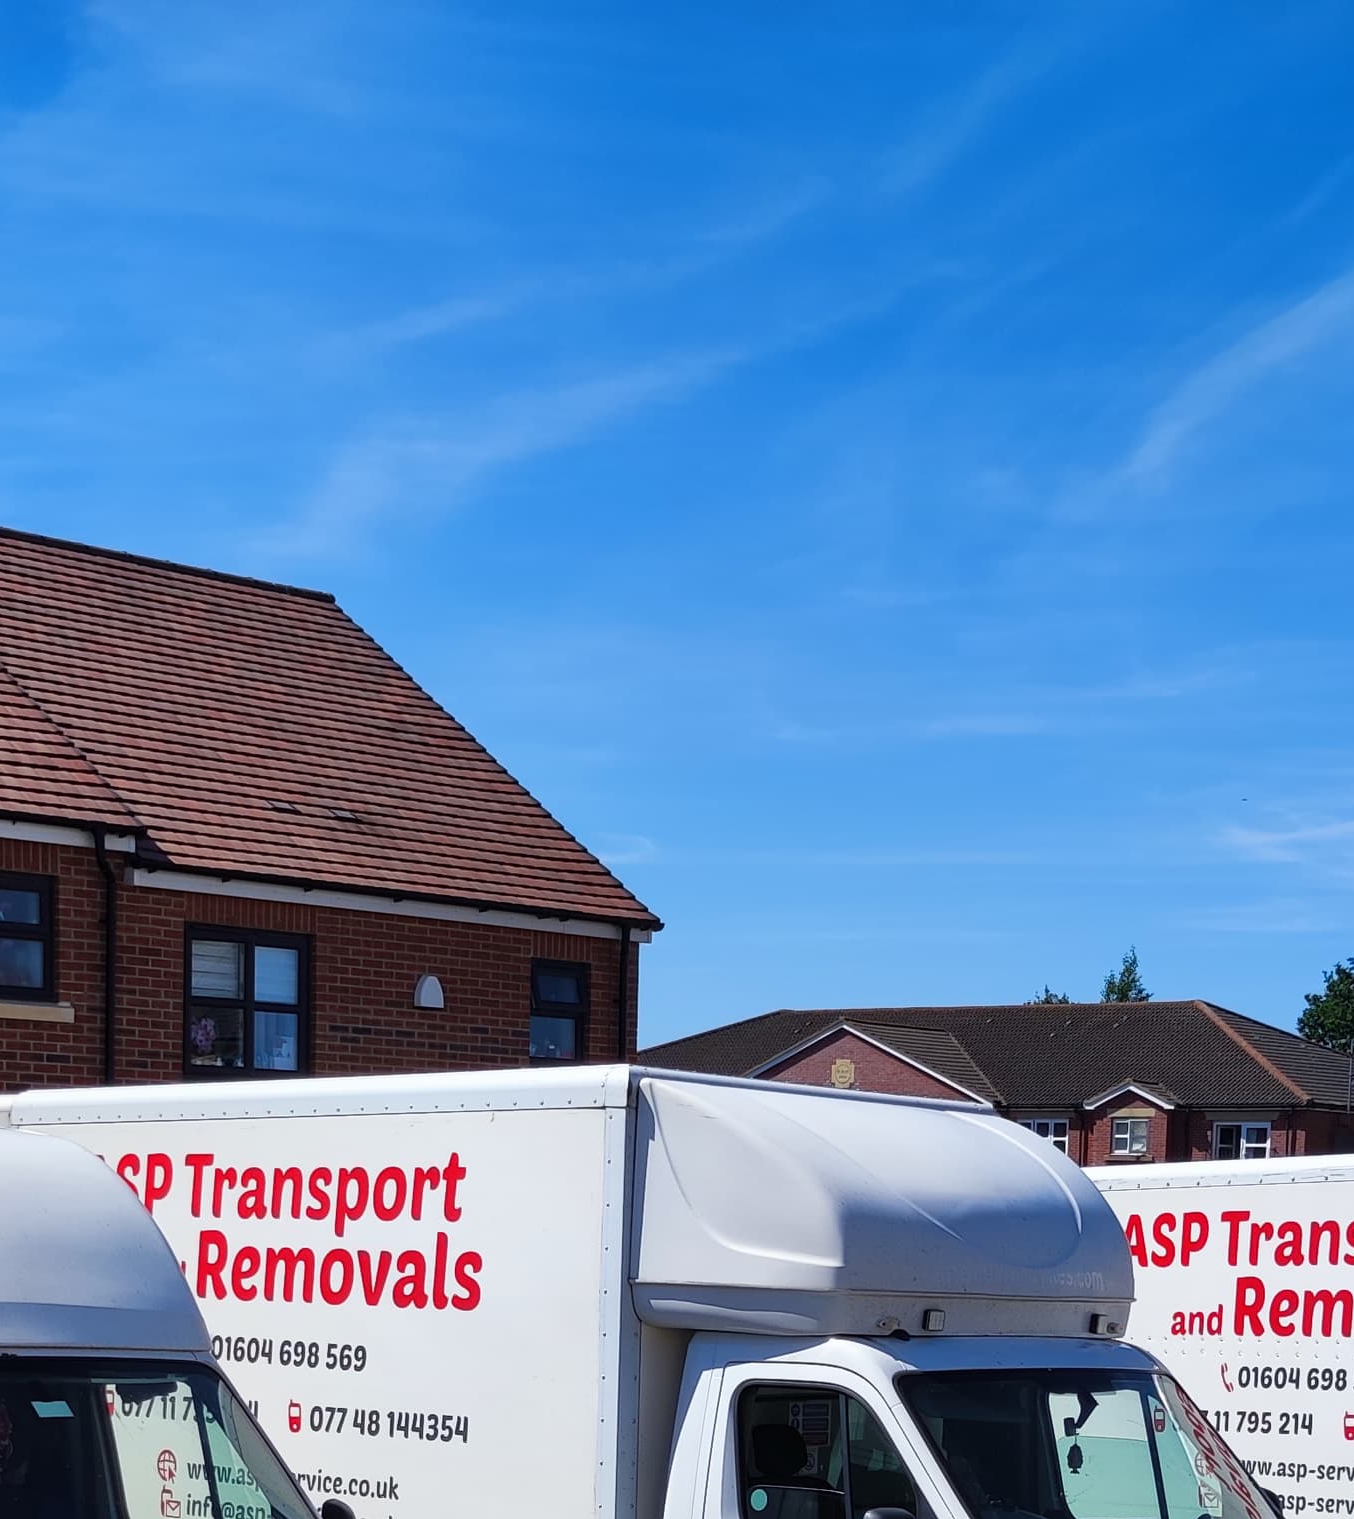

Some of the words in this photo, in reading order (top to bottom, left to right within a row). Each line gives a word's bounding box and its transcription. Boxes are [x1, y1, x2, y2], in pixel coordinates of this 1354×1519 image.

[97, 1153, 173, 1215] SP
[185, 1153, 466, 1237] Transport
[1125, 1212, 1209, 1268] ASP
[196, 1230, 482, 1311] Removals
[1171, 1304, 1223, 1335] and
[212, 1335, 273, 1364] 01604
[280, 1340, 319, 1368] 698
[326, 1344, 366, 1371] 569
[1238, 1366, 1300, 1389] 01604
[1307, 1368, 1346, 1391] 698
[310, 1406, 347, 1433] 077
[353, 1409, 379, 1436] 48
[387, 1412, 468, 1443] 144354
[1237, 1411, 1271, 1433] 795
[1279, 1413, 1312, 1435] 214
